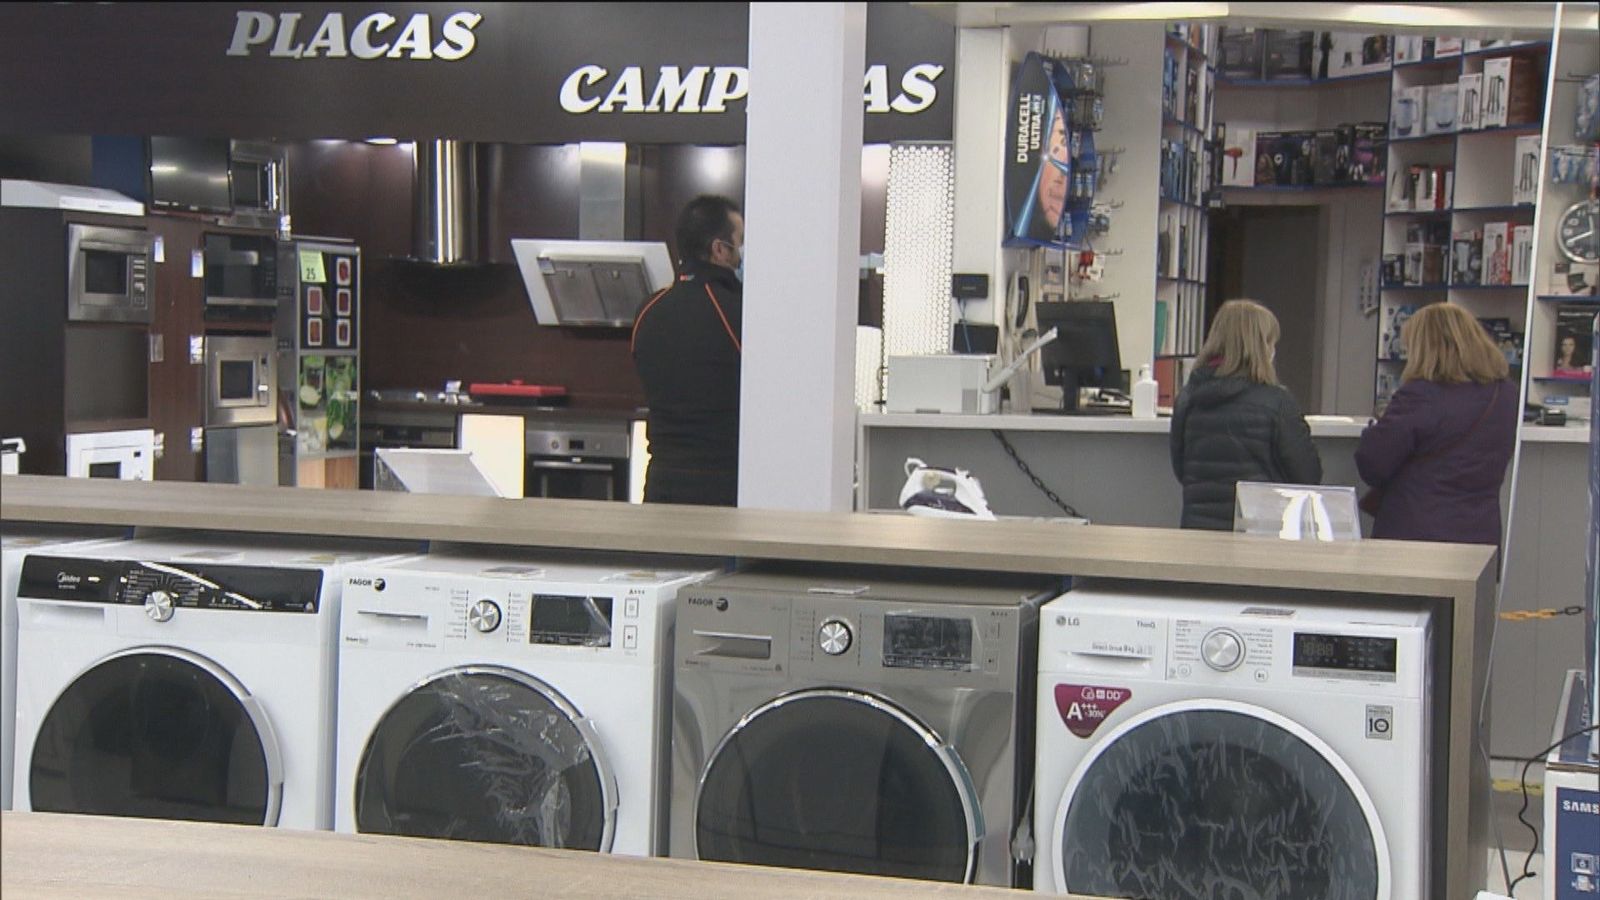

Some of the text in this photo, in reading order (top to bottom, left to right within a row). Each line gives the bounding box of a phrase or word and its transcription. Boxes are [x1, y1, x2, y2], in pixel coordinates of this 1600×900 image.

[226, 10, 482, 61] PLACAS
[559, 63, 944, 114] CAMPAS
[1016, 93, 1031, 163] DURACELL
[1030, 113, 1042, 150] ULTRA
[306, 267, 316, 280] 25
[348, 578, 373, 587] FAGOR
[688, 597, 714, 607] FAGOR
[1368, 717, 1390, 733] 10
